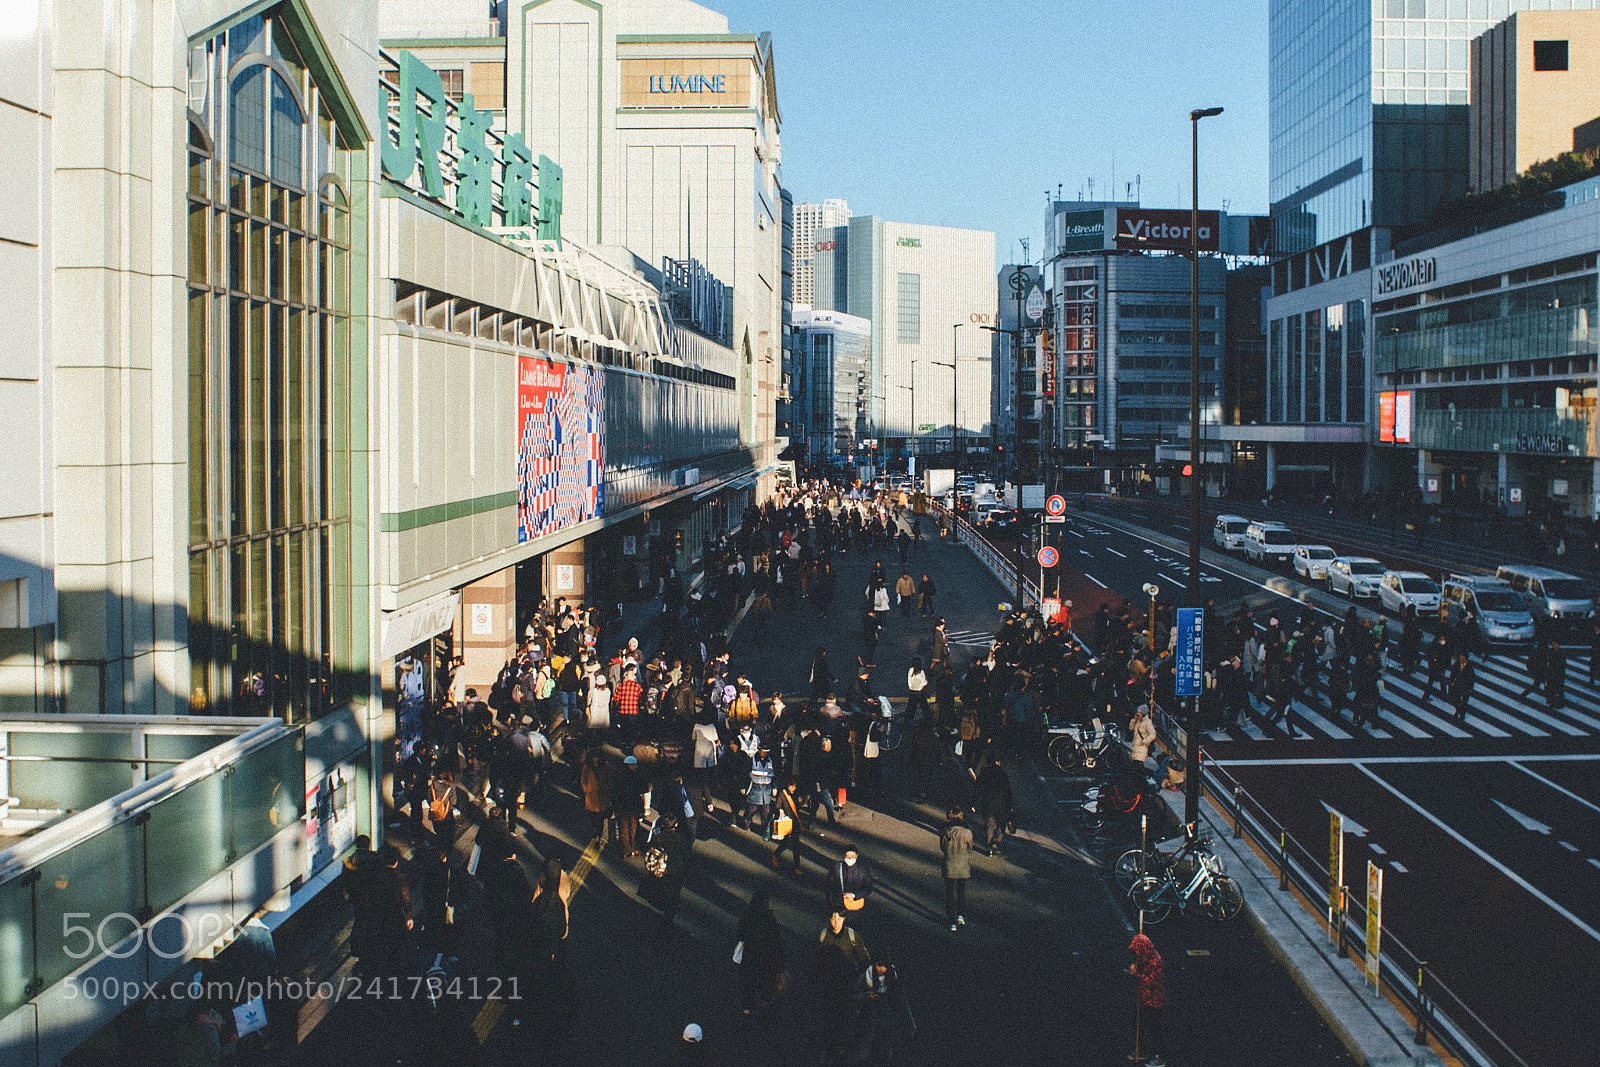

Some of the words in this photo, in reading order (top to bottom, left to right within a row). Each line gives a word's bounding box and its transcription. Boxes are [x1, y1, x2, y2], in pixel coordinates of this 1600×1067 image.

[649, 74, 726, 94] LUMINE
[1125, 219, 1211, 239] Victora
[1178, 655, 1186, 693] 入れません
